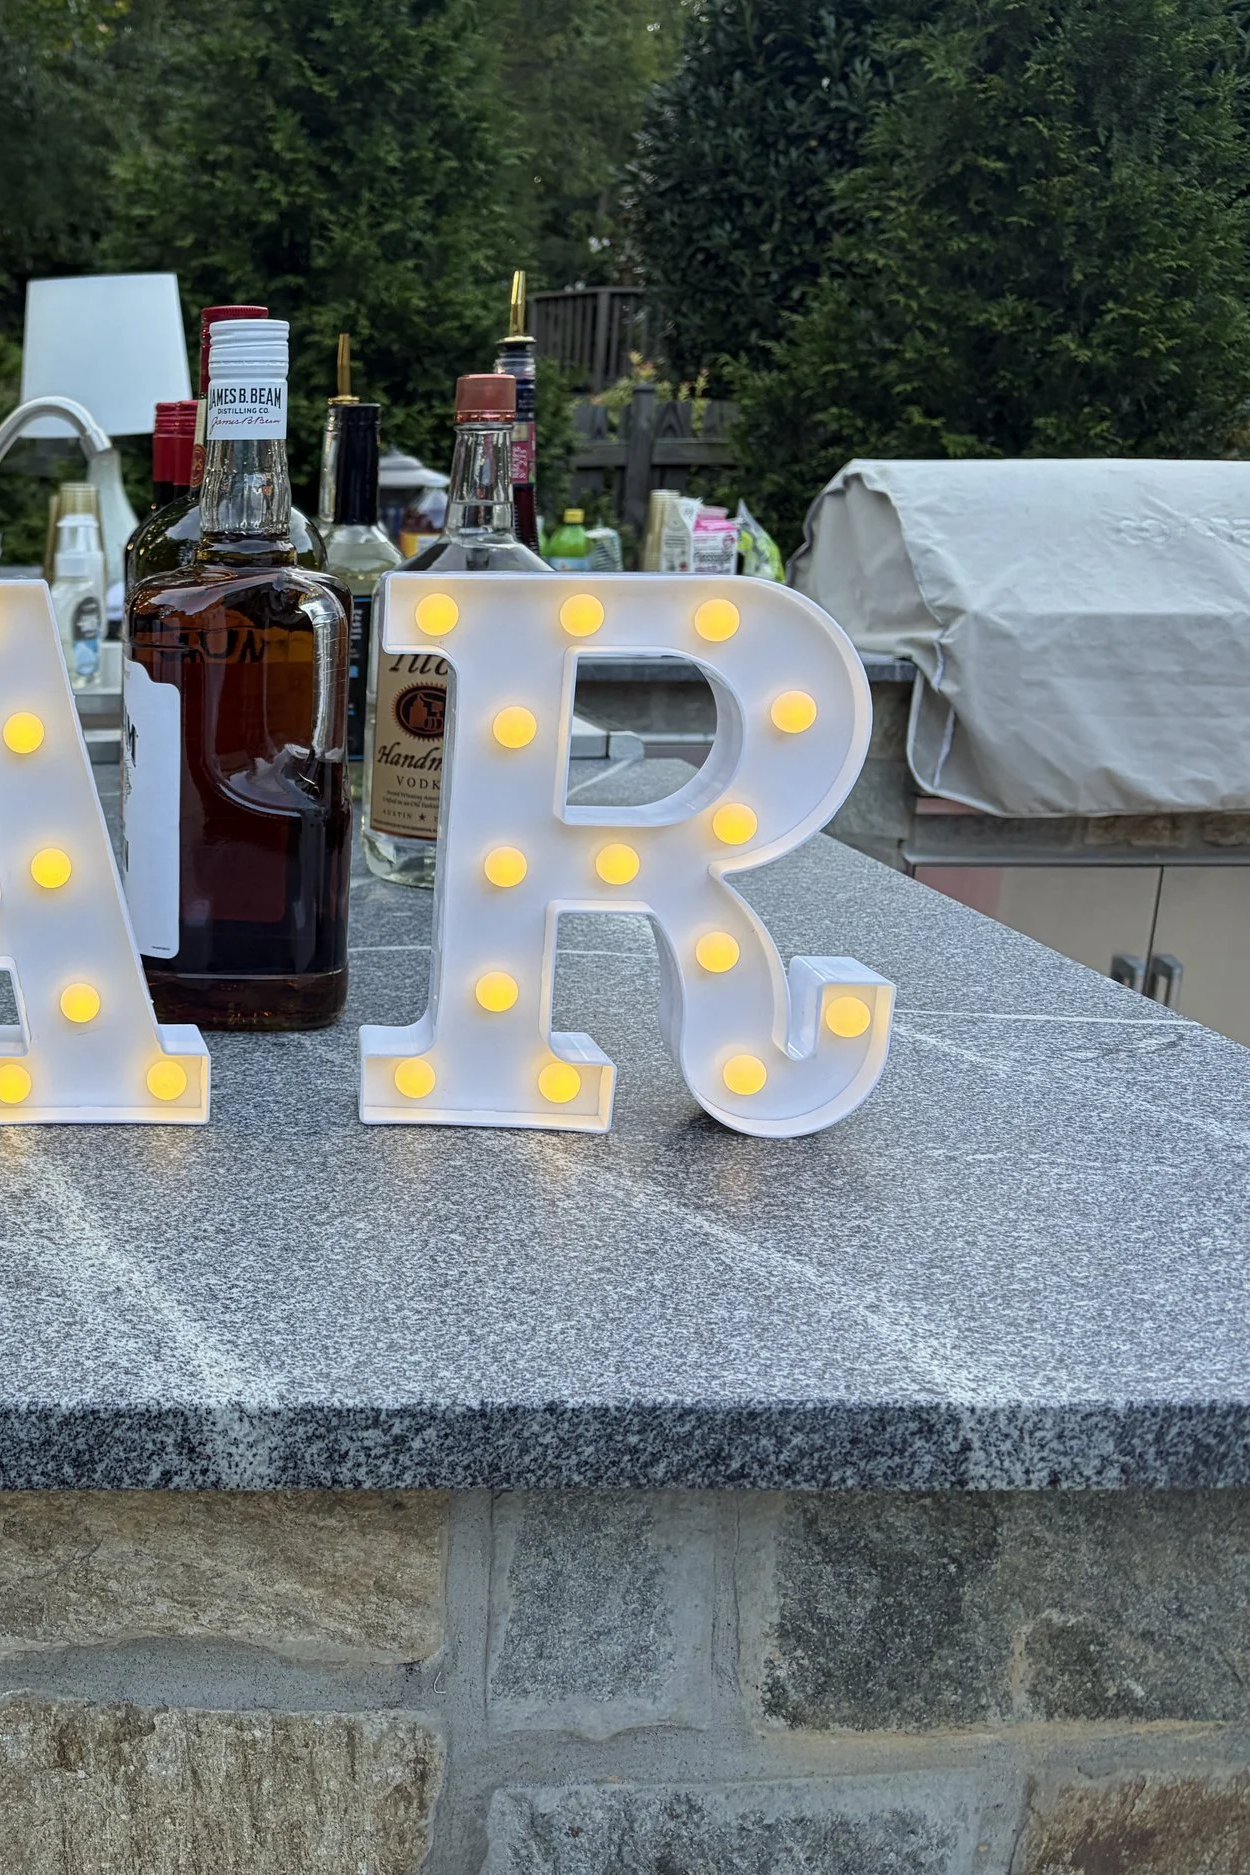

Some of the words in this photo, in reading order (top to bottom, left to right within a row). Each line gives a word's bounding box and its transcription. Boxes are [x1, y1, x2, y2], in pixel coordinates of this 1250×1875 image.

[238, 388, 249, 404] B.
[250, 387, 281, 409] BEAM
[217, 407, 257, 415] DISTILLING
